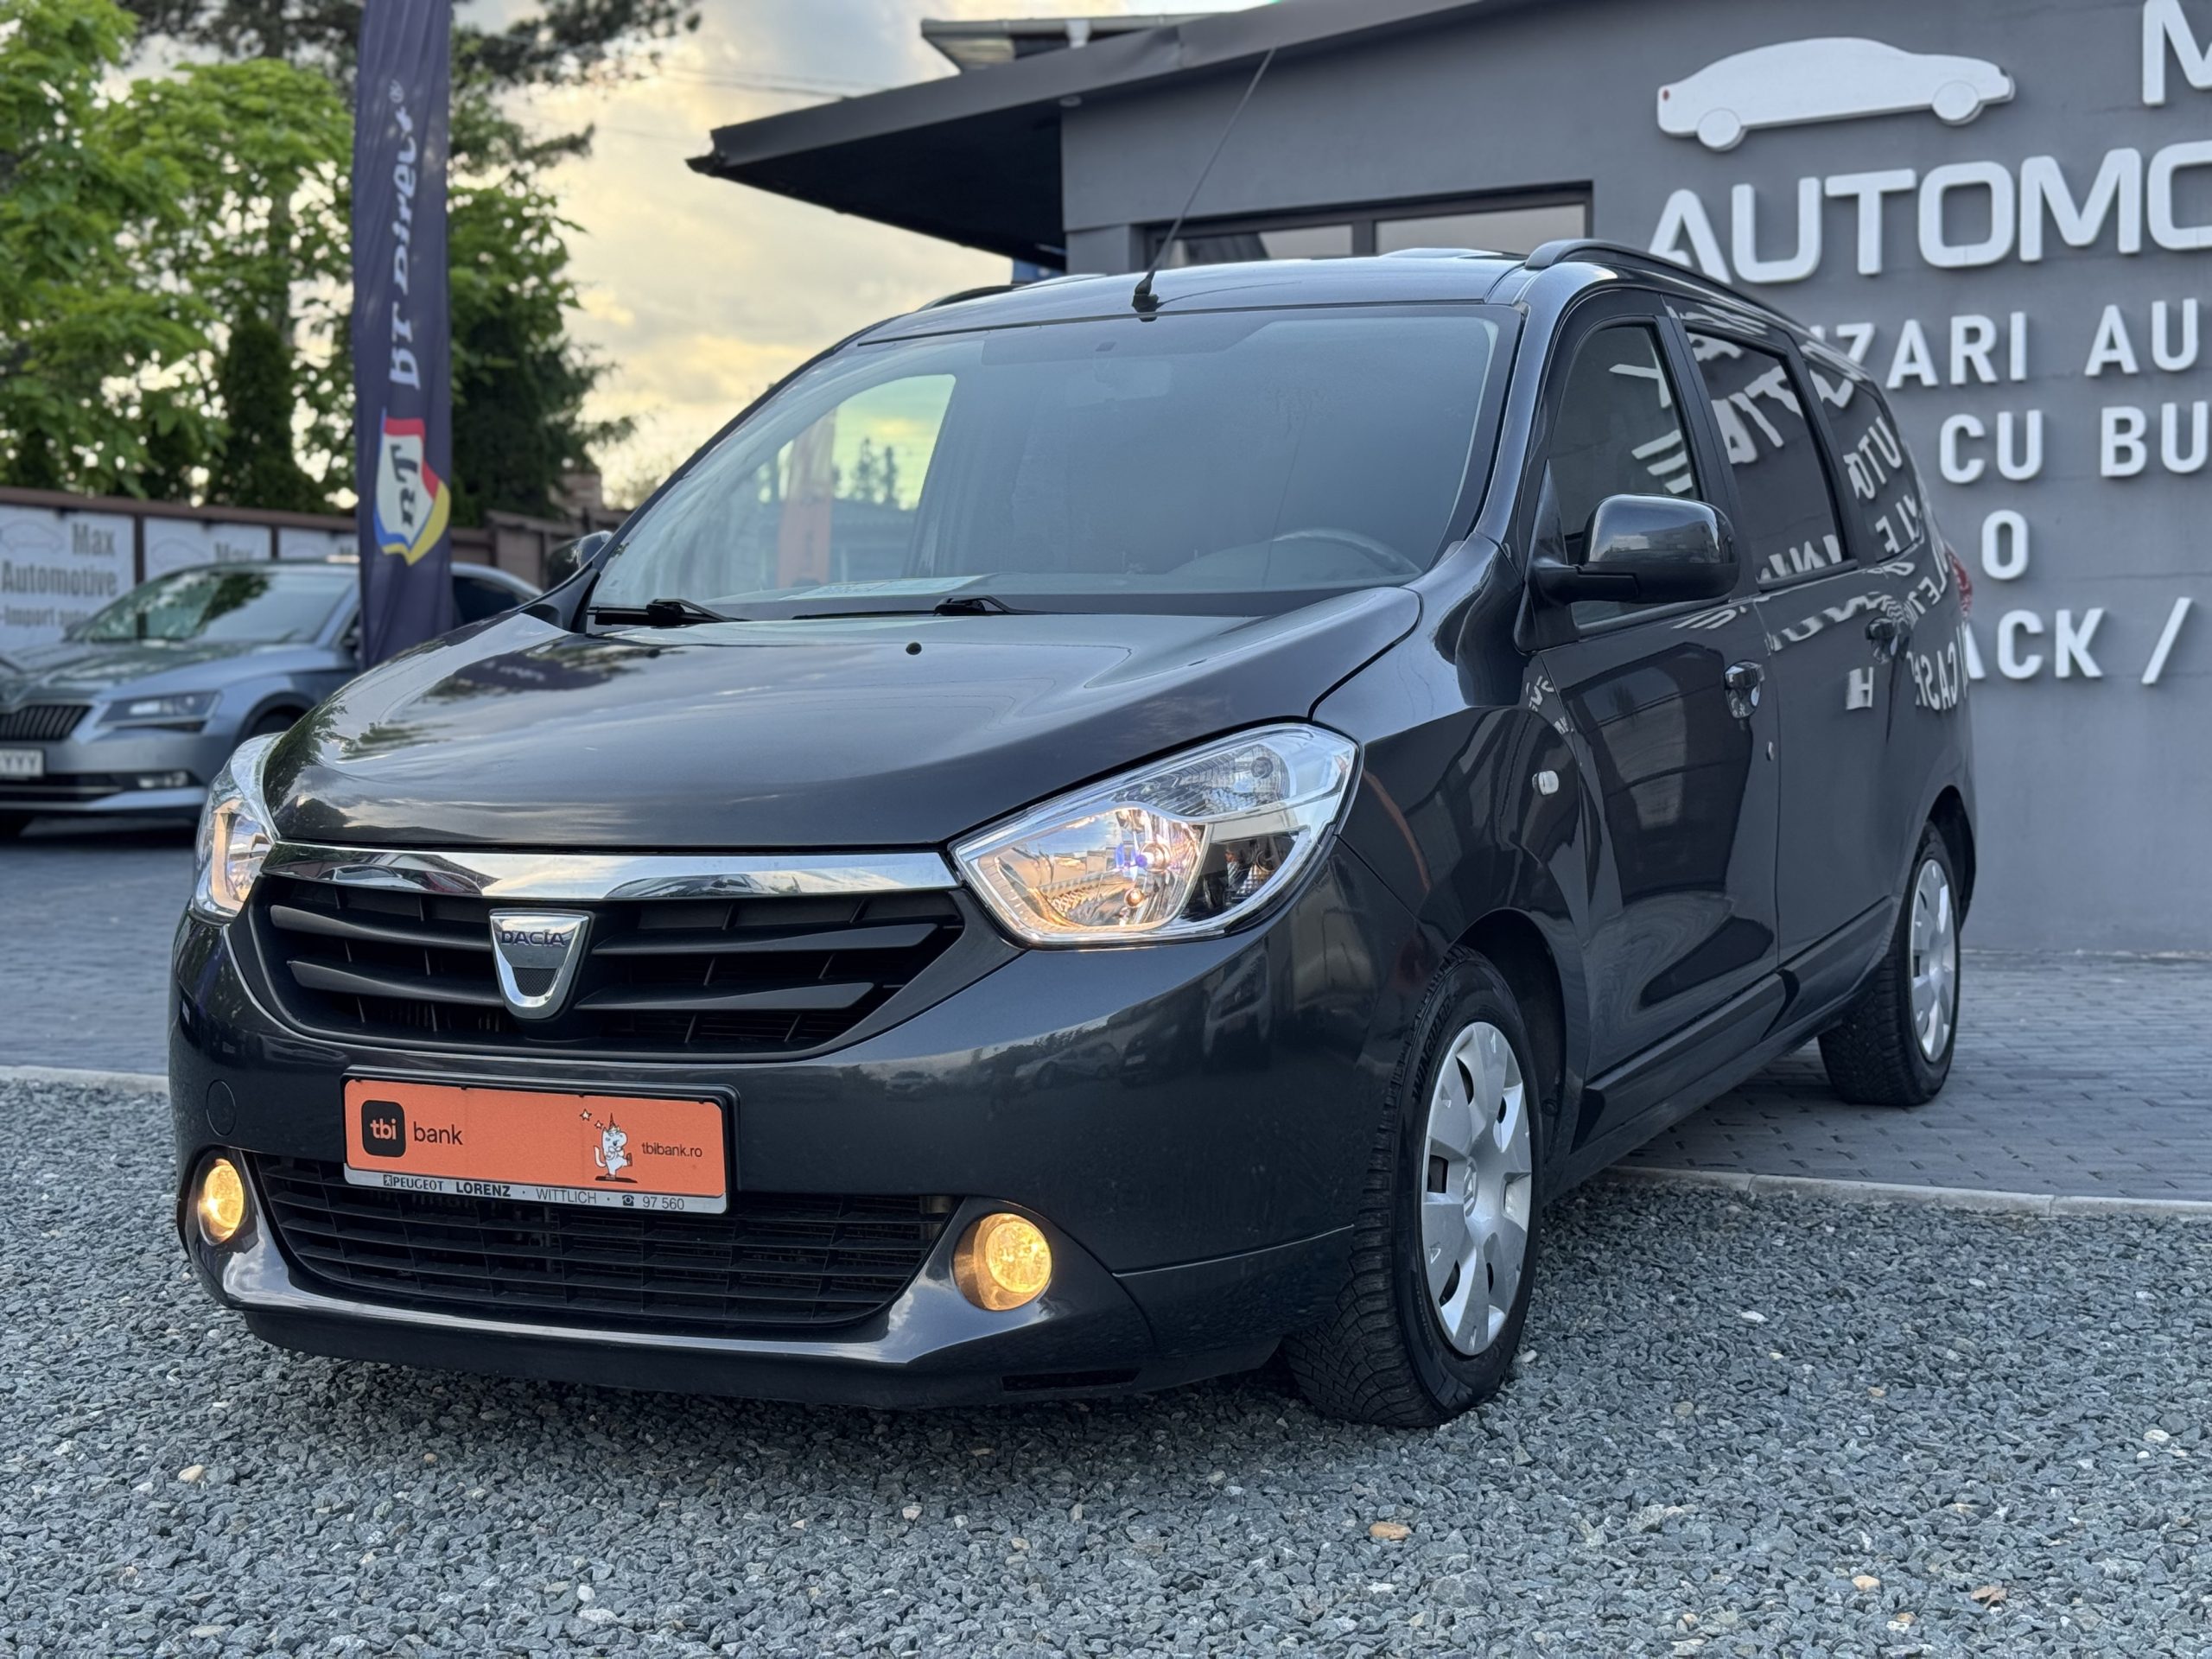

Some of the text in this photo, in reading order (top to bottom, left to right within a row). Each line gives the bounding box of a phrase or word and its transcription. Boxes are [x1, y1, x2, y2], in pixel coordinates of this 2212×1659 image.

[1649, 140, 2212, 283] AUTOMO
[1809, 298, 2199, 390] ZARI AU
[1939, 401, 2209, 484] CU BU
[72, 522, 116, 556] Max
[2, 560, 118, 598] Automotive
[501, 930, 566, 947] DACIA
[370, 1118, 464, 1146] tbi bank
[641, 1141, 703, 1159] tbibank.ro
[391, 1175, 685, 1211] PEUGEOT LORENZ WITTLICH 97 560
